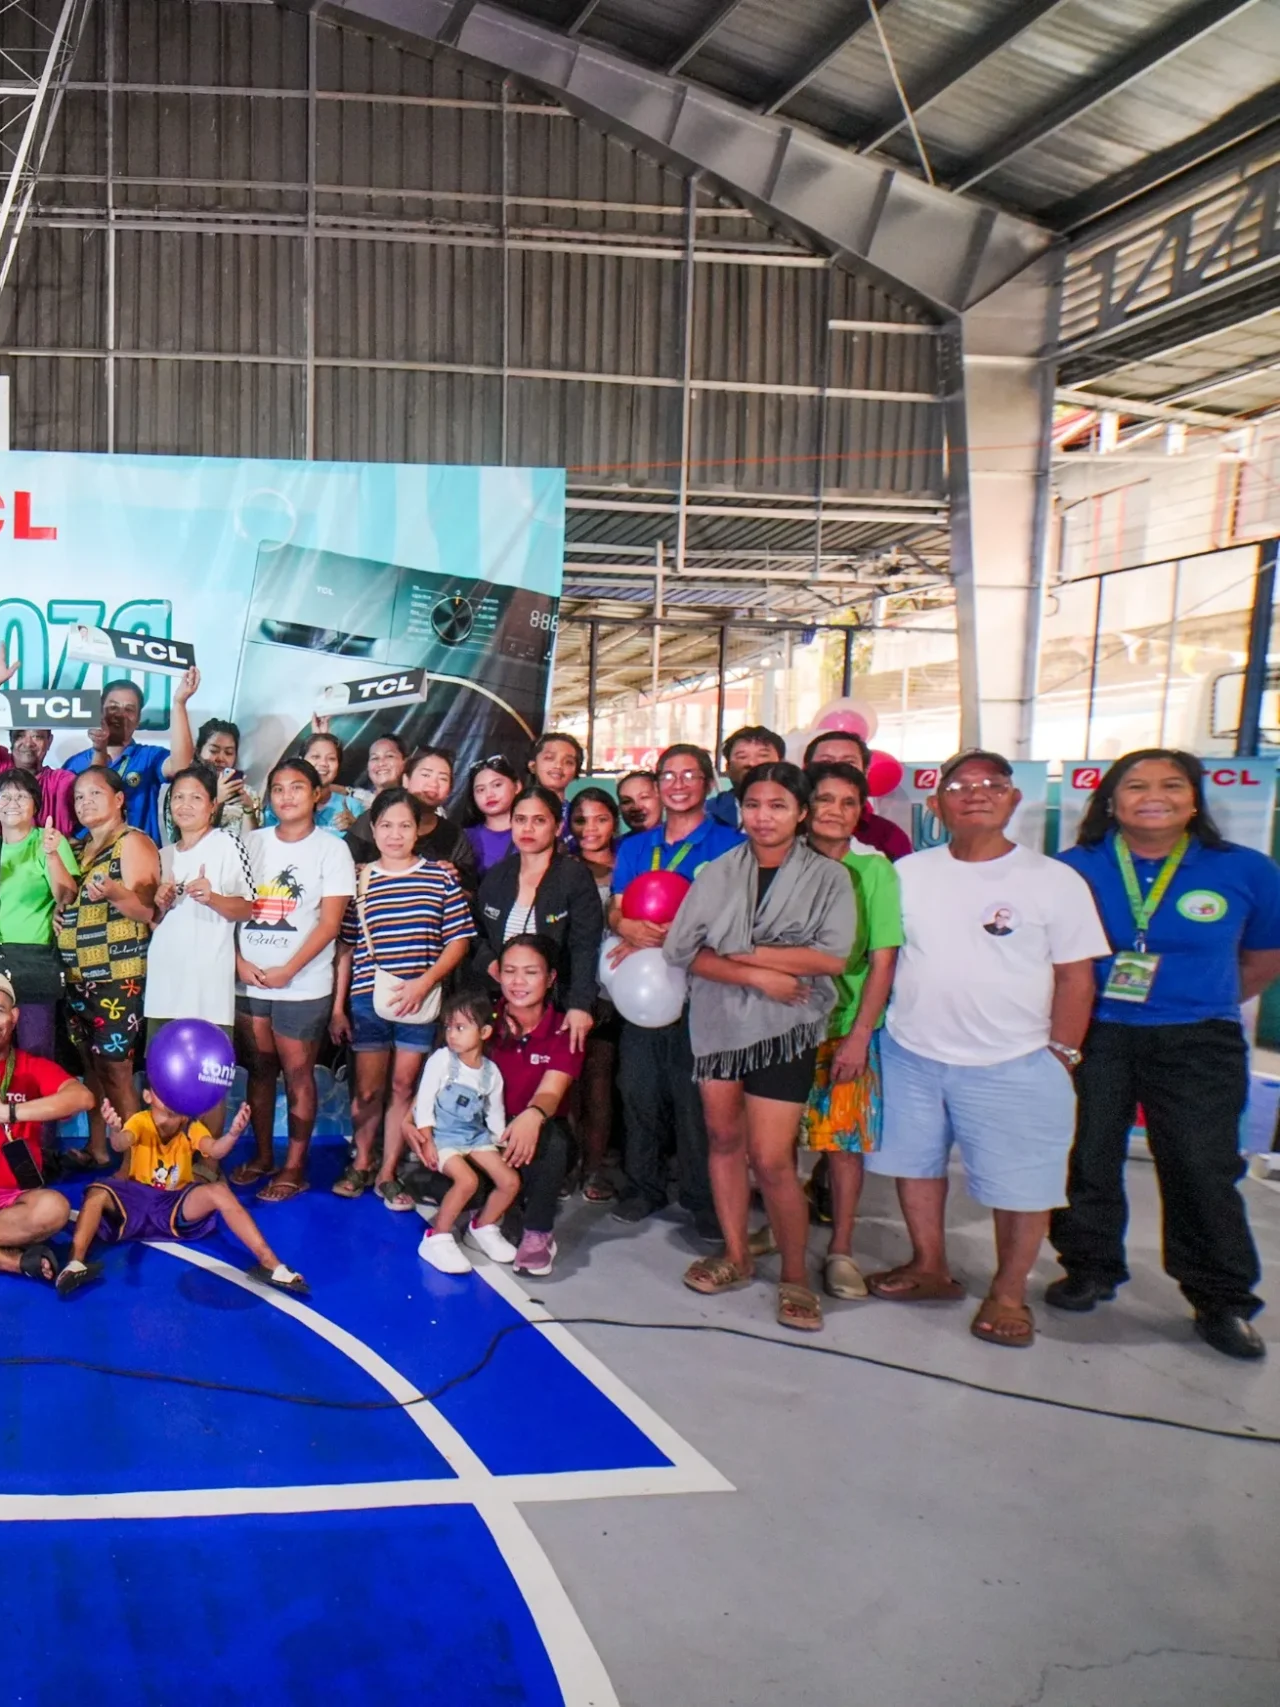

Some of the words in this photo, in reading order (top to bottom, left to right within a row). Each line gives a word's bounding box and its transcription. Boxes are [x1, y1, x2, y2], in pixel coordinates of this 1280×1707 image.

[316, 585, 335, 596] TCL
[121, 637, 189, 665] TCL
[357, 676, 415, 699] TCL
[21, 697, 92, 718] TCL
[1202, 769, 1261, 786] CL
